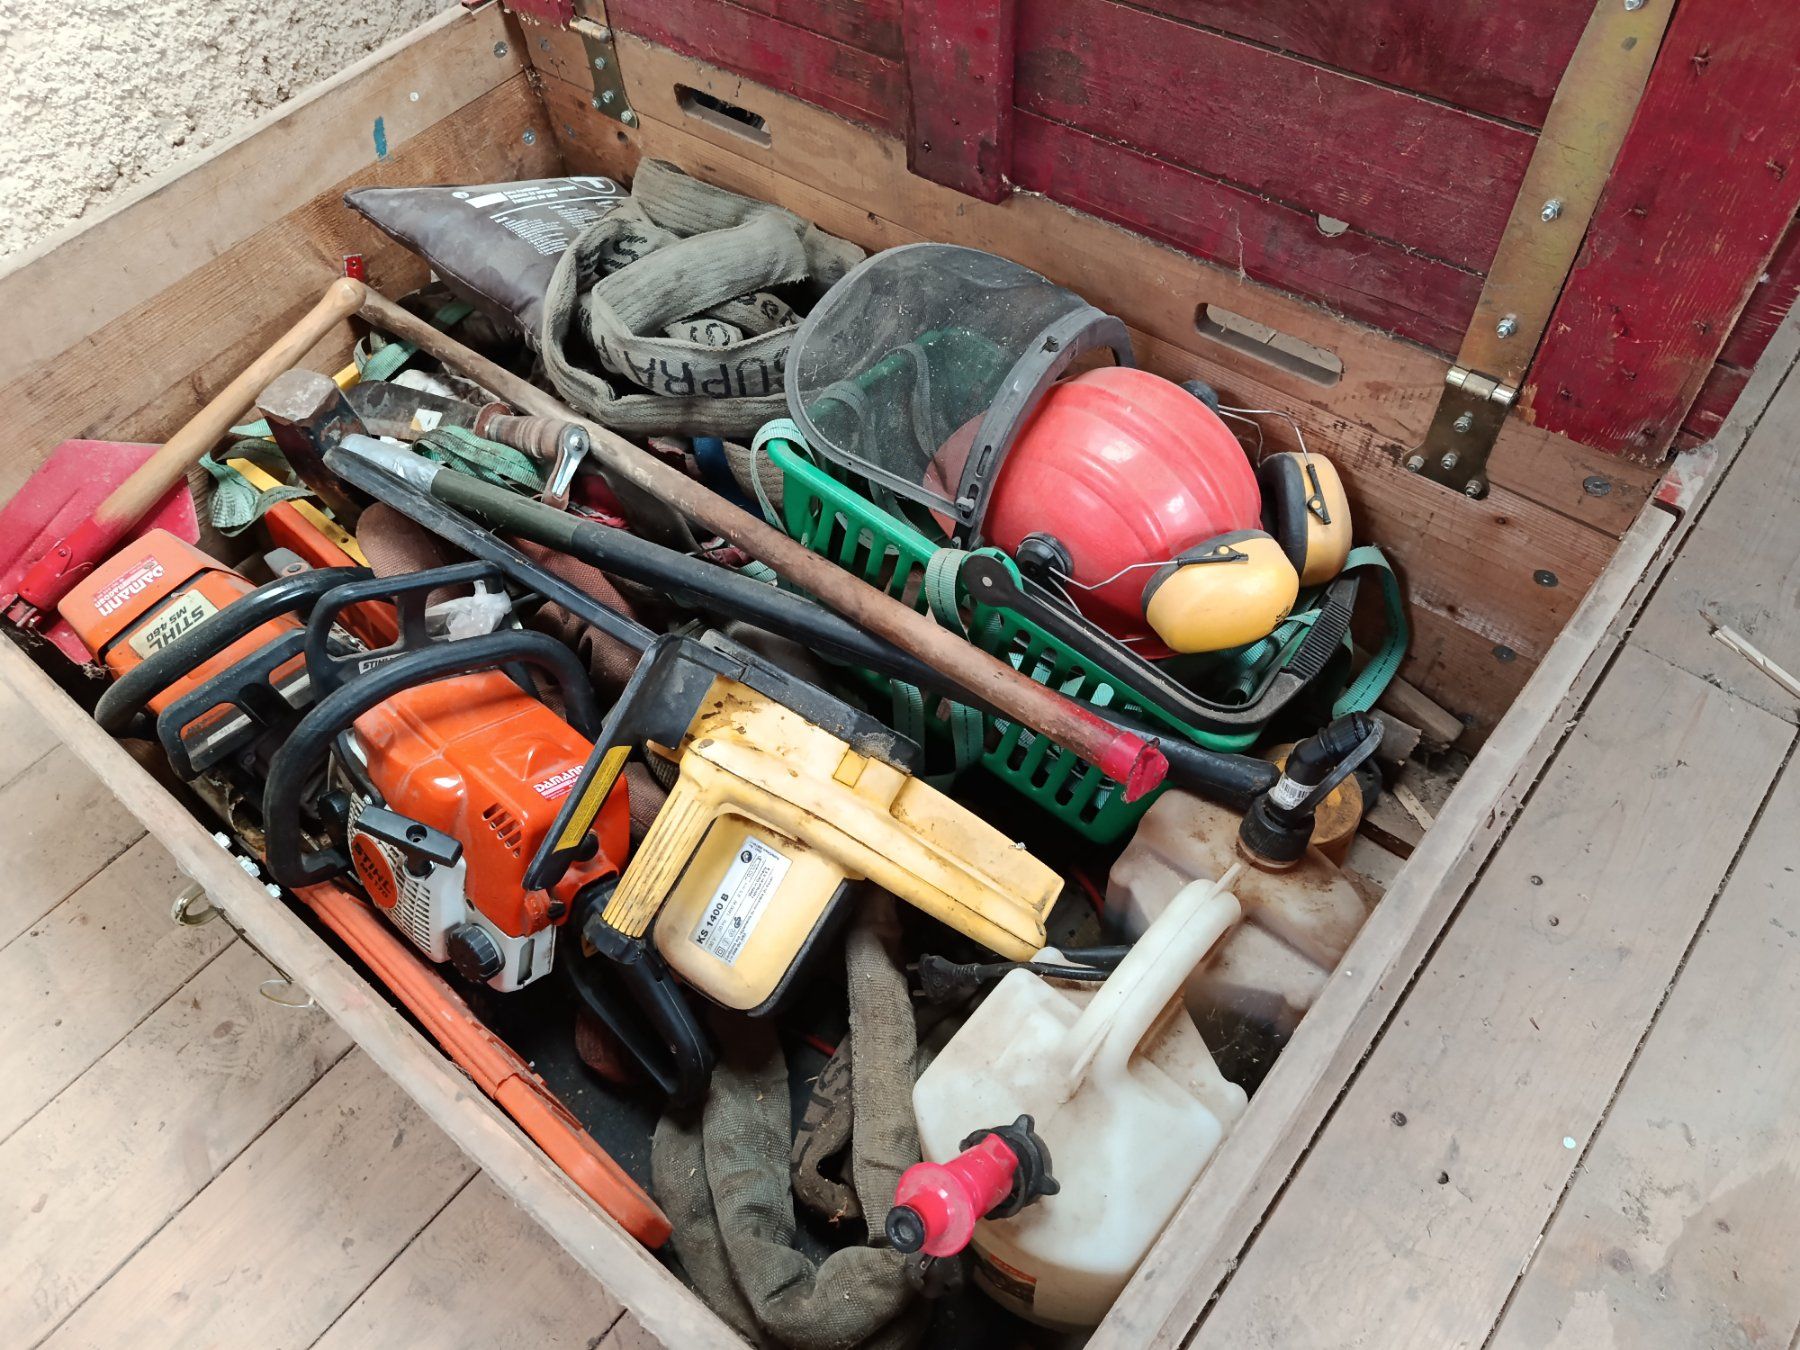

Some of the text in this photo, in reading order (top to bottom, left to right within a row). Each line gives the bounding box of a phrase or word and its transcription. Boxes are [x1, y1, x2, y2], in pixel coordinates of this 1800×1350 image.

[146, 606, 188, 641] MS 460
[149, 605, 204, 650] STIHL
[352, 843, 391, 894] STIHL
[696, 893, 729, 944] KS 1400 B
